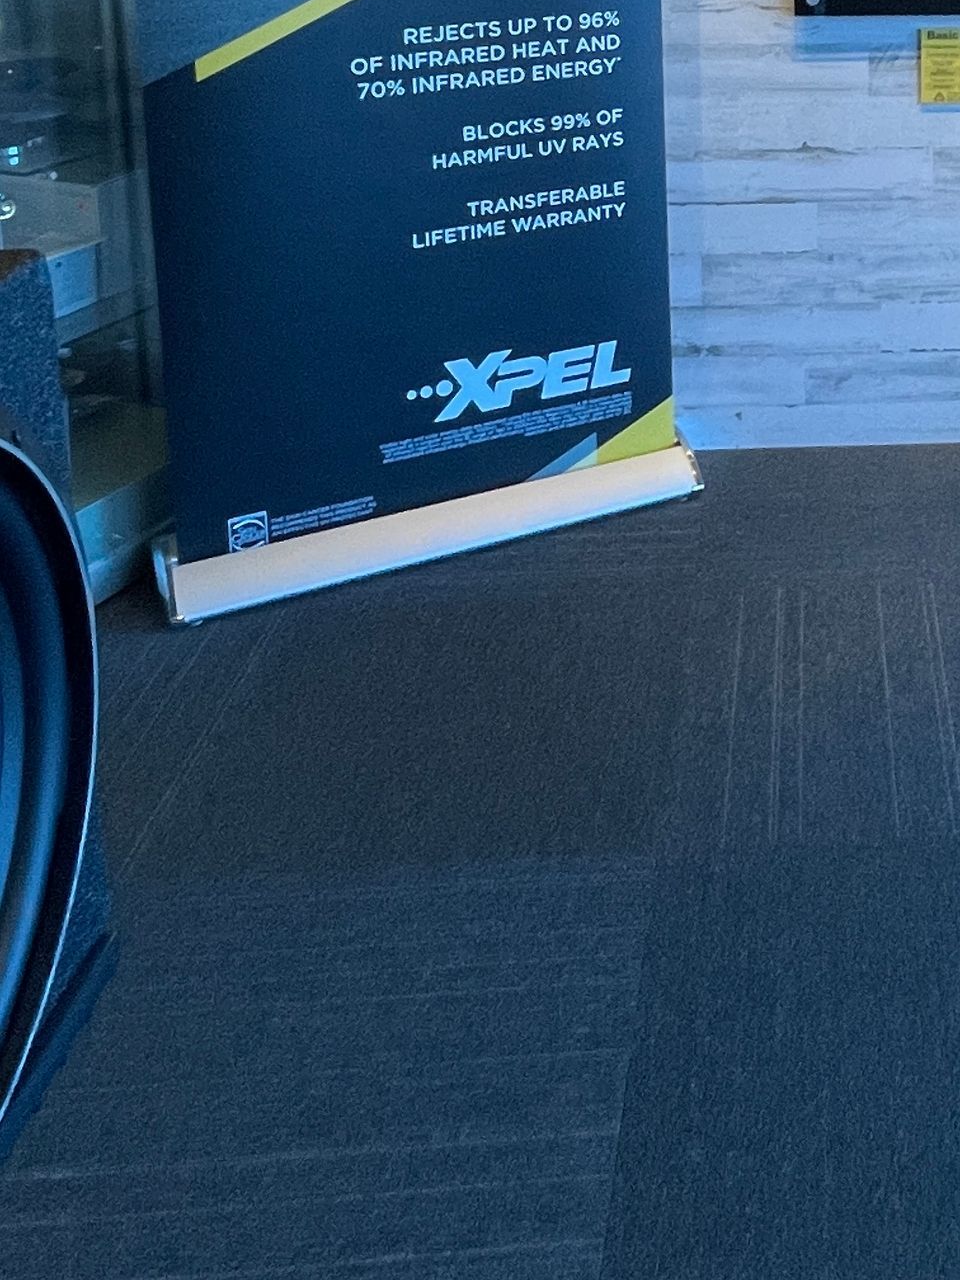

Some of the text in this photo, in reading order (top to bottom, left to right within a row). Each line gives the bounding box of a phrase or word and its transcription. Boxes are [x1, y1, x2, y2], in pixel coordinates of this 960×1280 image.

[403, 11, 620, 45] REJECTS UP TO 96%
[927, 30, 959, 40] Basic
[350, 34, 621, 76] OF INFRARED HEAT AND
[357, 79, 405, 100] 70%
[412, 67, 525, 95] INFRARED
[462, 109, 623, 142] BLOCKS 99% OF
[432, 131, 624, 169] HARMFUL UV RAYS
[467, 181, 626, 217] TRANSFERABLE
[412, 202, 627, 249] LIFETIME WARRANTY
[434, 340, 632, 423] XPEL
